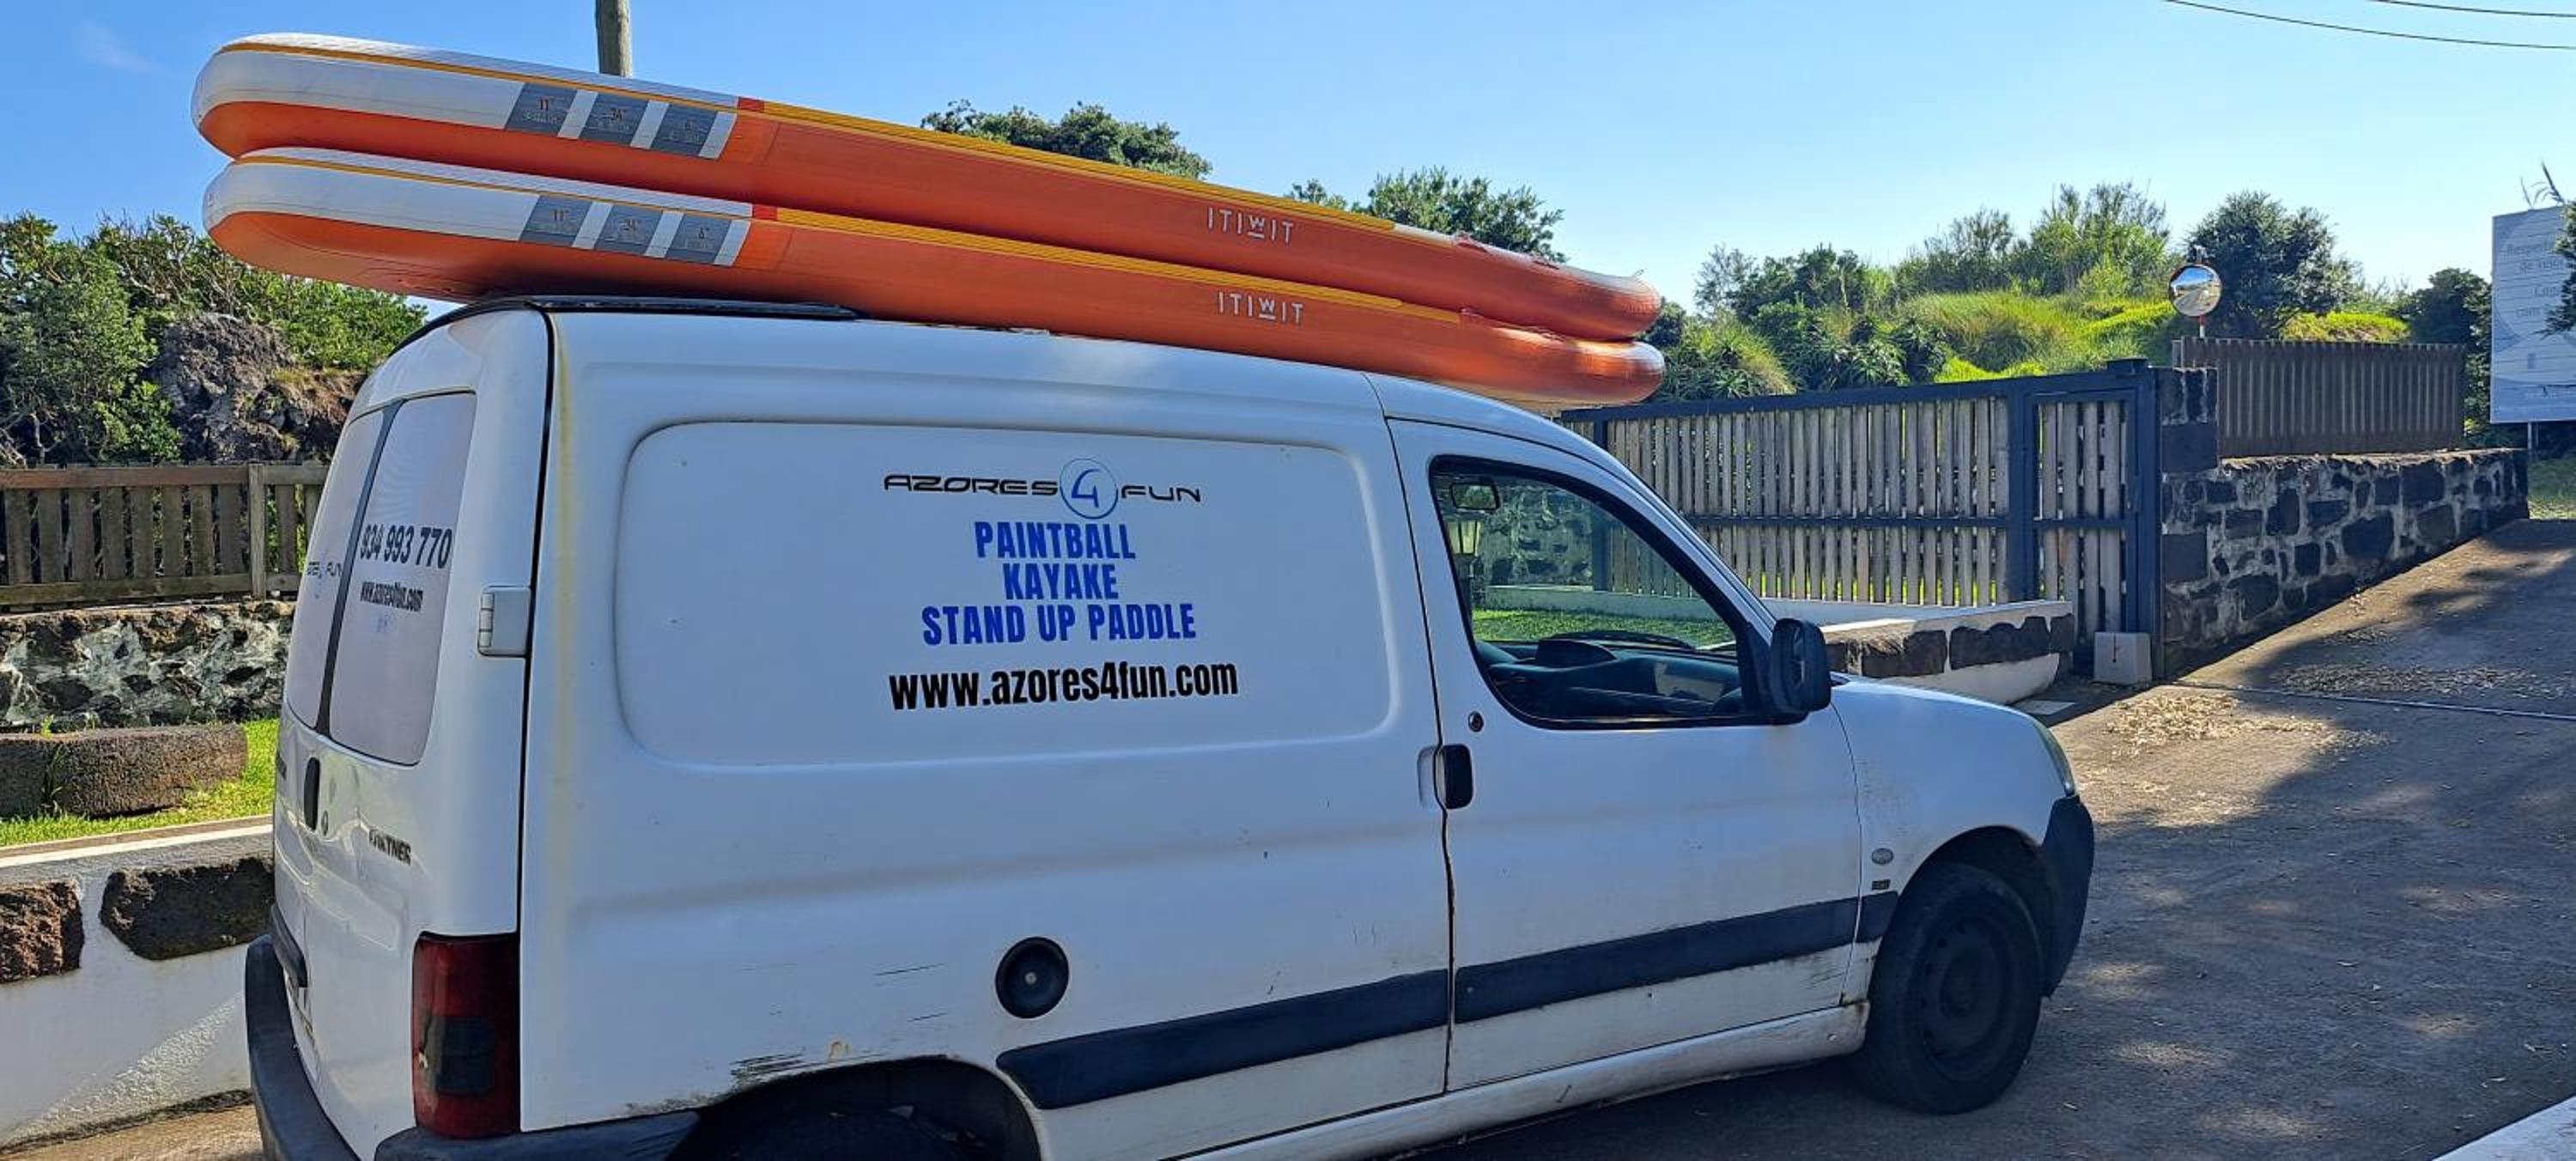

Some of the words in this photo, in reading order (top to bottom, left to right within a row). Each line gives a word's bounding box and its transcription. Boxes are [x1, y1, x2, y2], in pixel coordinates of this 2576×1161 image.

[1208, 207, 1294, 244] ITIWIT
[1218, 291, 1303, 325] ITIWIT
[884, 474, 1058, 495] AZORES
[1121, 485, 1201, 503] FUN
[361, 524, 384, 560] 934
[384, 525, 415, 563] 993
[416, 526, 453, 569] 770
[975, 521, 1136, 560] PAINTBALL
[1003, 563, 1119, 600] KAYAKE
[921, 605, 1026, 646] STAND
[1036, 604, 1076, 642] UP
[1089, 603, 1197, 641] PADDLE
[888, 660, 1239, 710] www.azores4fun.com
